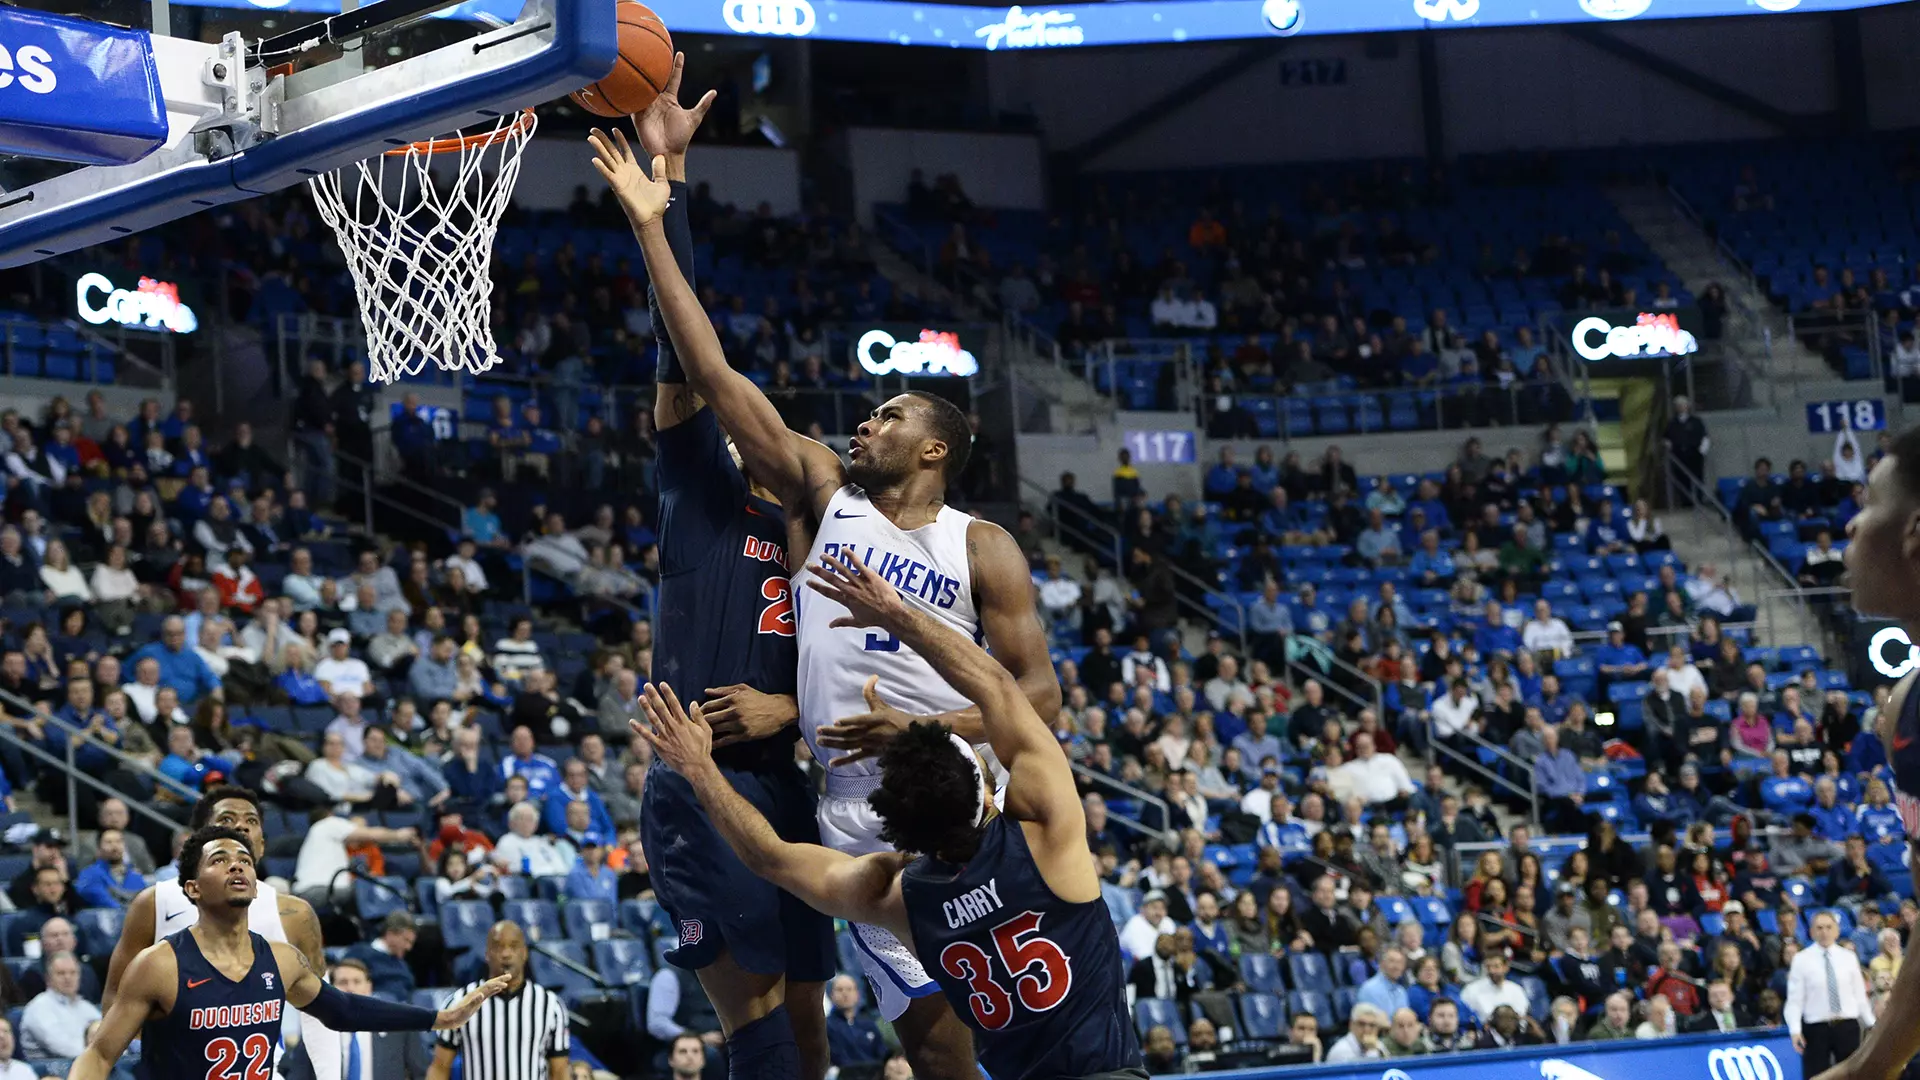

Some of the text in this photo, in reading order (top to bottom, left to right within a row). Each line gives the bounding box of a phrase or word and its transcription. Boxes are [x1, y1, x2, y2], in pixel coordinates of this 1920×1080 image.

[1815, 400, 1876, 432] 118
[1132, 432, 1186, 461] 117
[942, 878, 1004, 929] CARRY
[940, 910, 1072, 1031] 35
[189, 999, 281, 1030] DUQUESNE
[204, 1033, 271, 1080] 22
